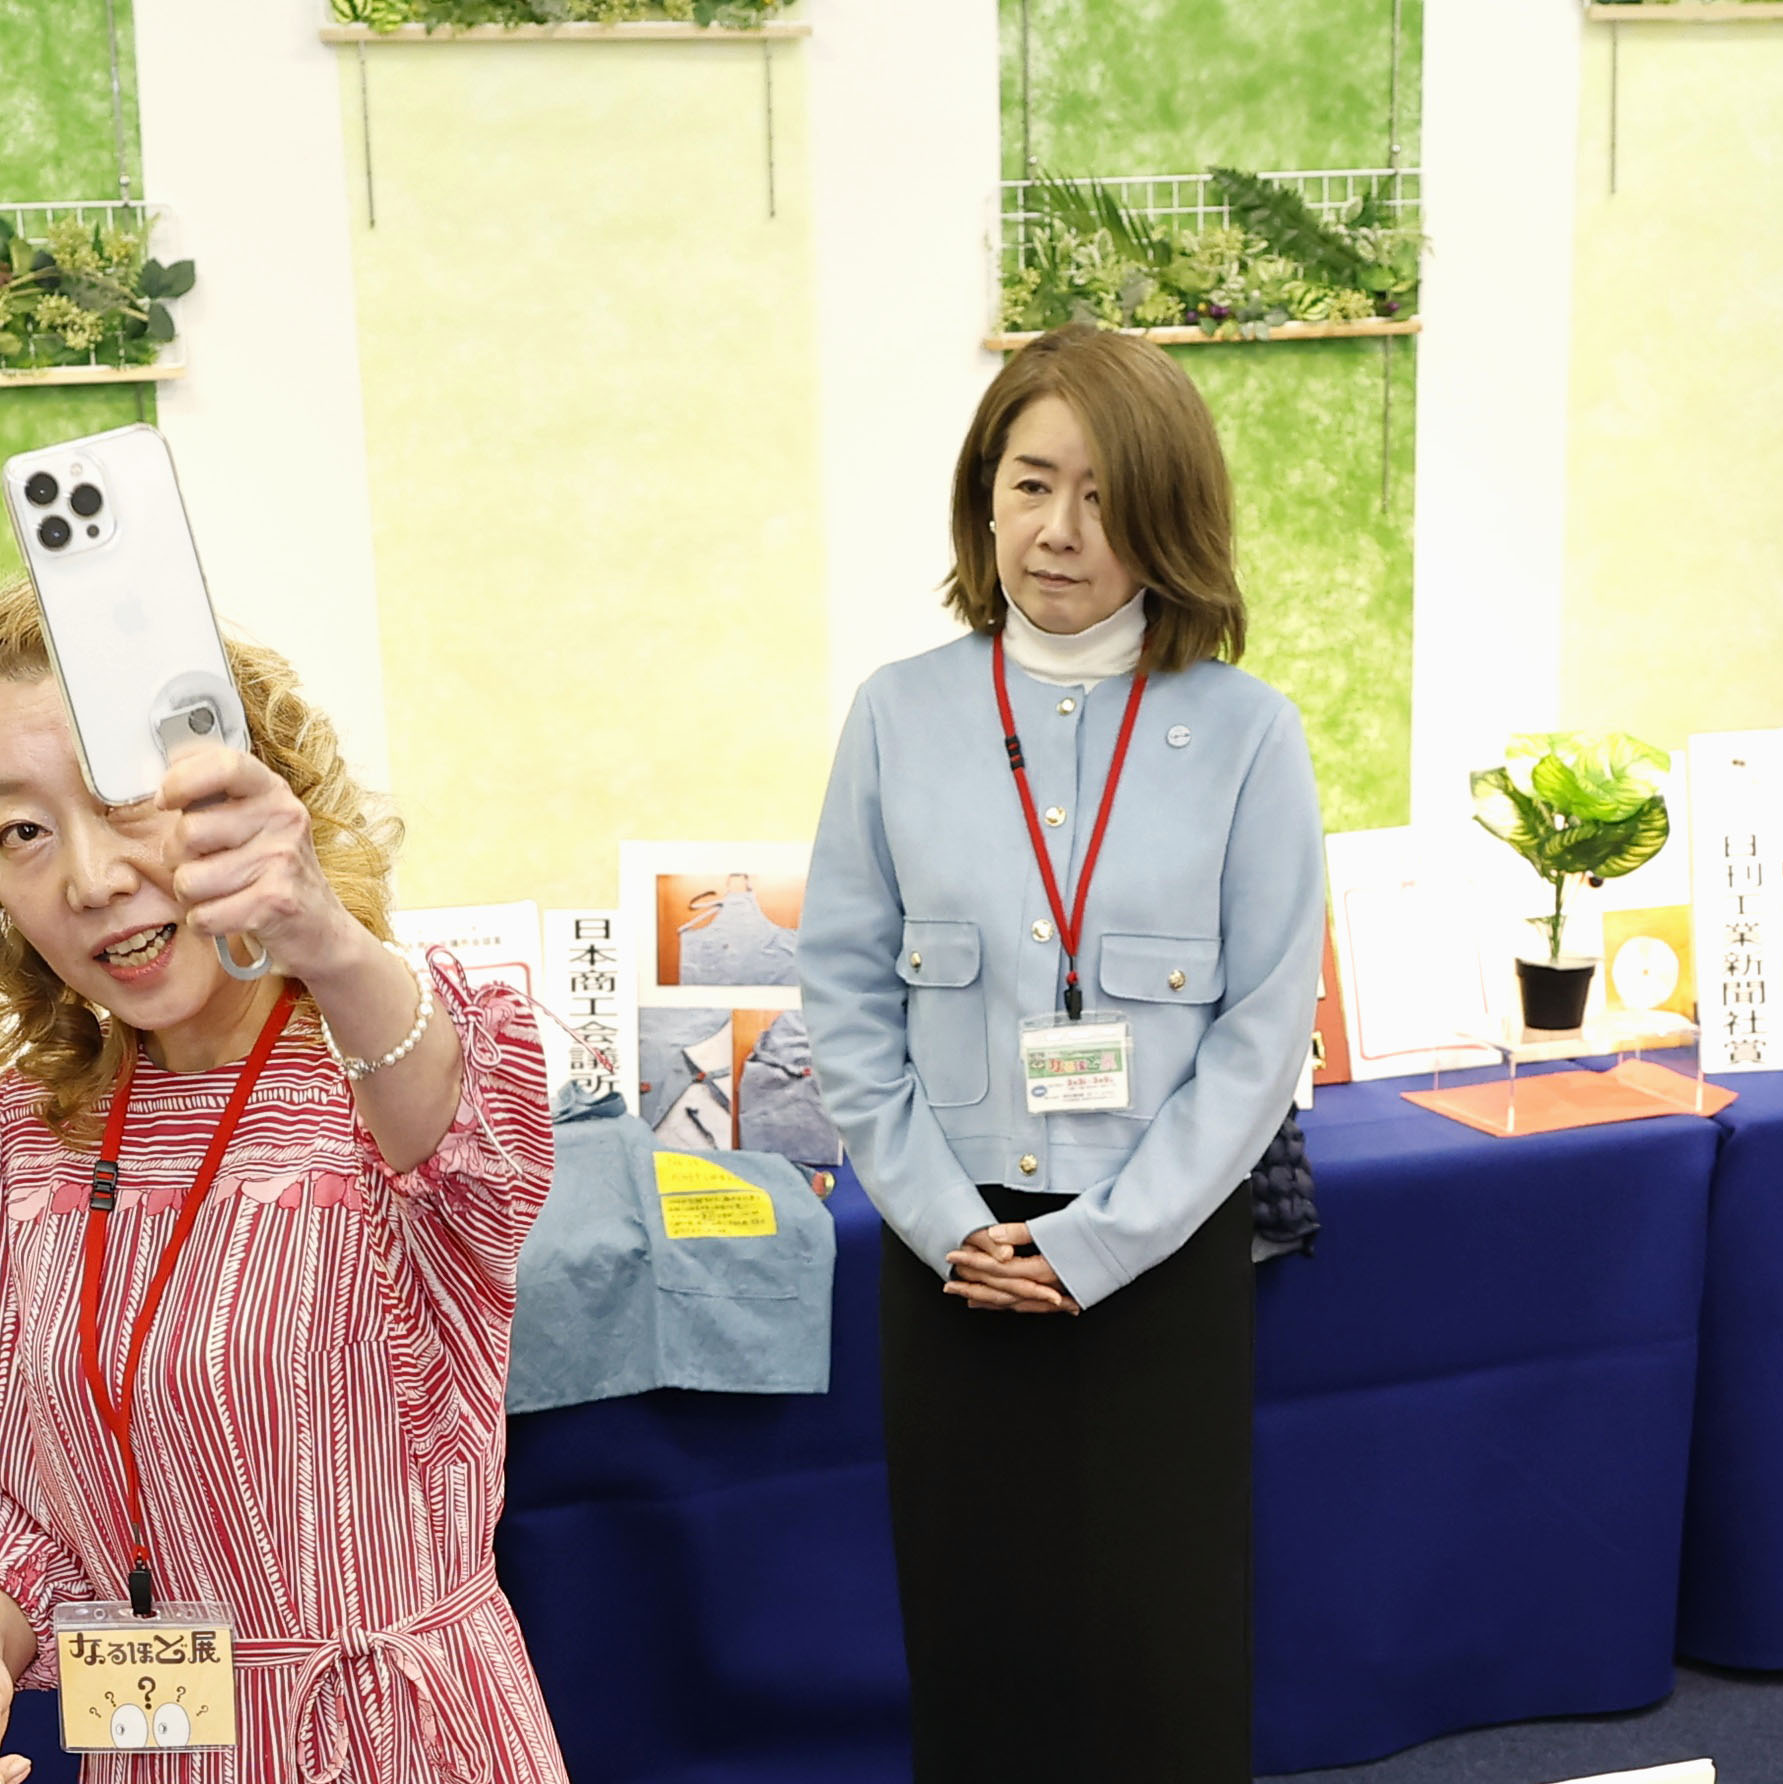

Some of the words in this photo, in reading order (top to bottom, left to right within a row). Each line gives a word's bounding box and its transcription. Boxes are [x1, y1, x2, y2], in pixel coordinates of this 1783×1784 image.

[1723, 834, 1768, 1065] 日刊工業新聞社賞
[68, 1630, 221, 1666] なるほど展
